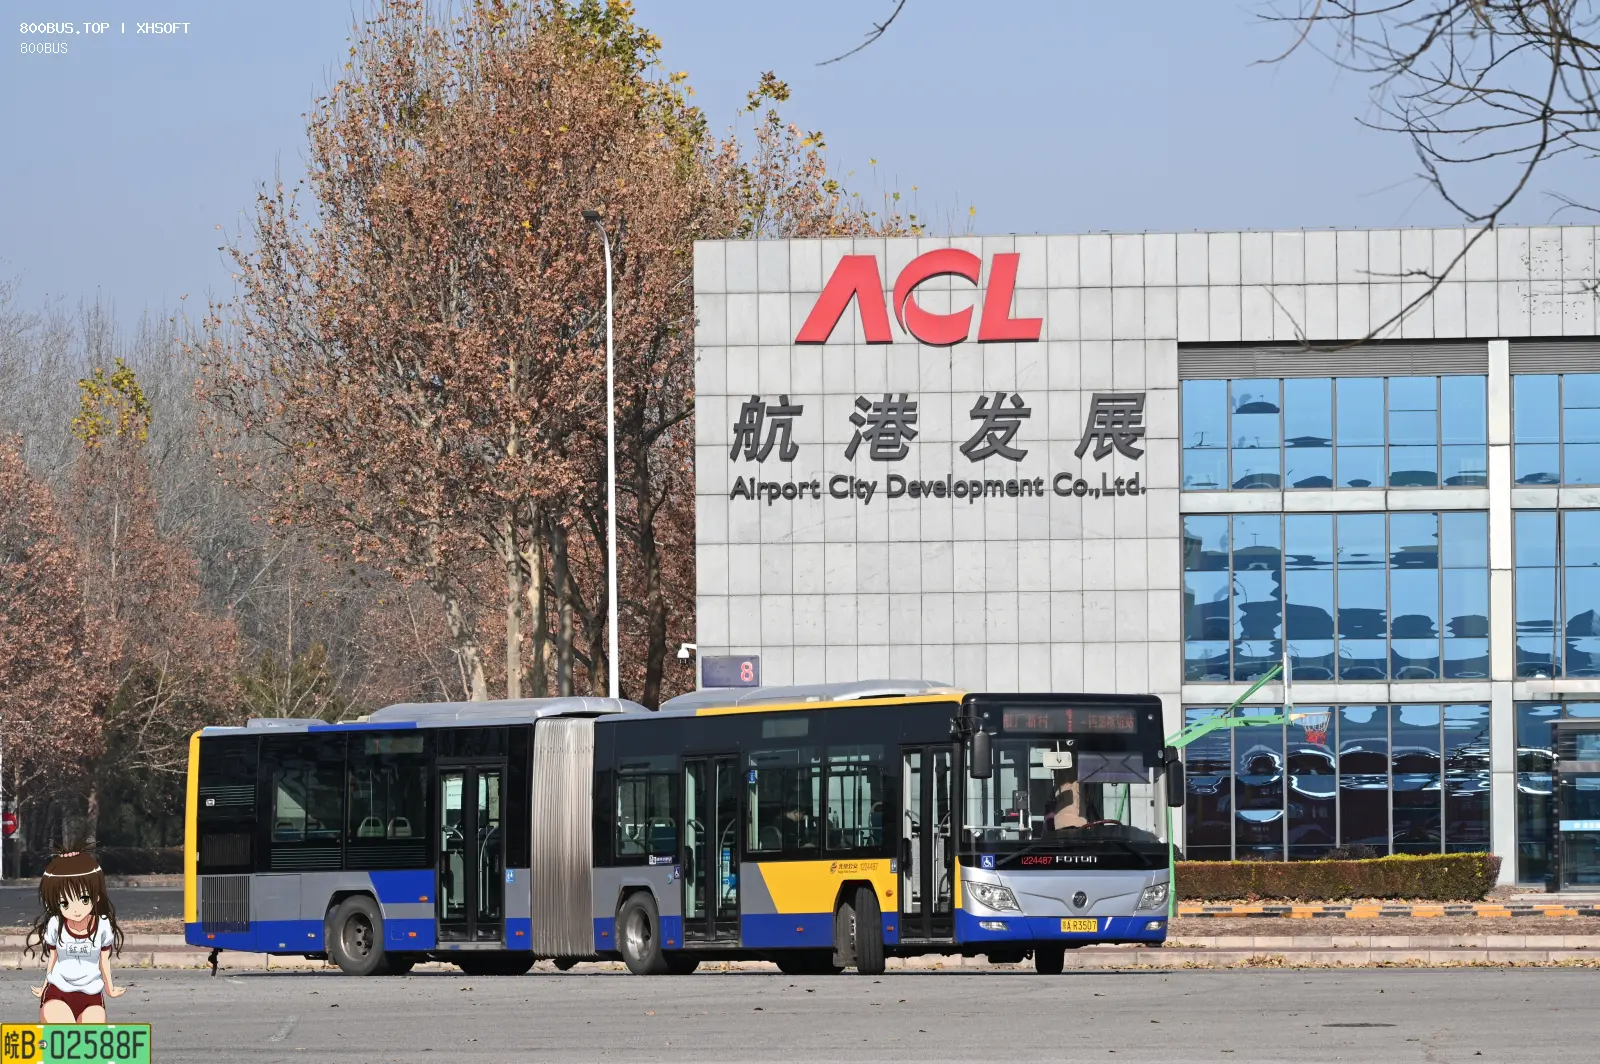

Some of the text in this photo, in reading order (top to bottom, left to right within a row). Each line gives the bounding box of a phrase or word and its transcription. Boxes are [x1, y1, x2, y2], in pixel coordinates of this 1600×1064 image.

[794, 248, 1044, 346] ACL
[730, 392, 1146, 462] 航港发展
[730, 472, 1146, 504] Airport City Development Co.,Ltd.
[740, 661, 754, 682] 8
[1065, 708, 1073, 732] 1
[1056, 855, 1097, 864] FOTON
[1073, 920, 1096, 931] R3507
